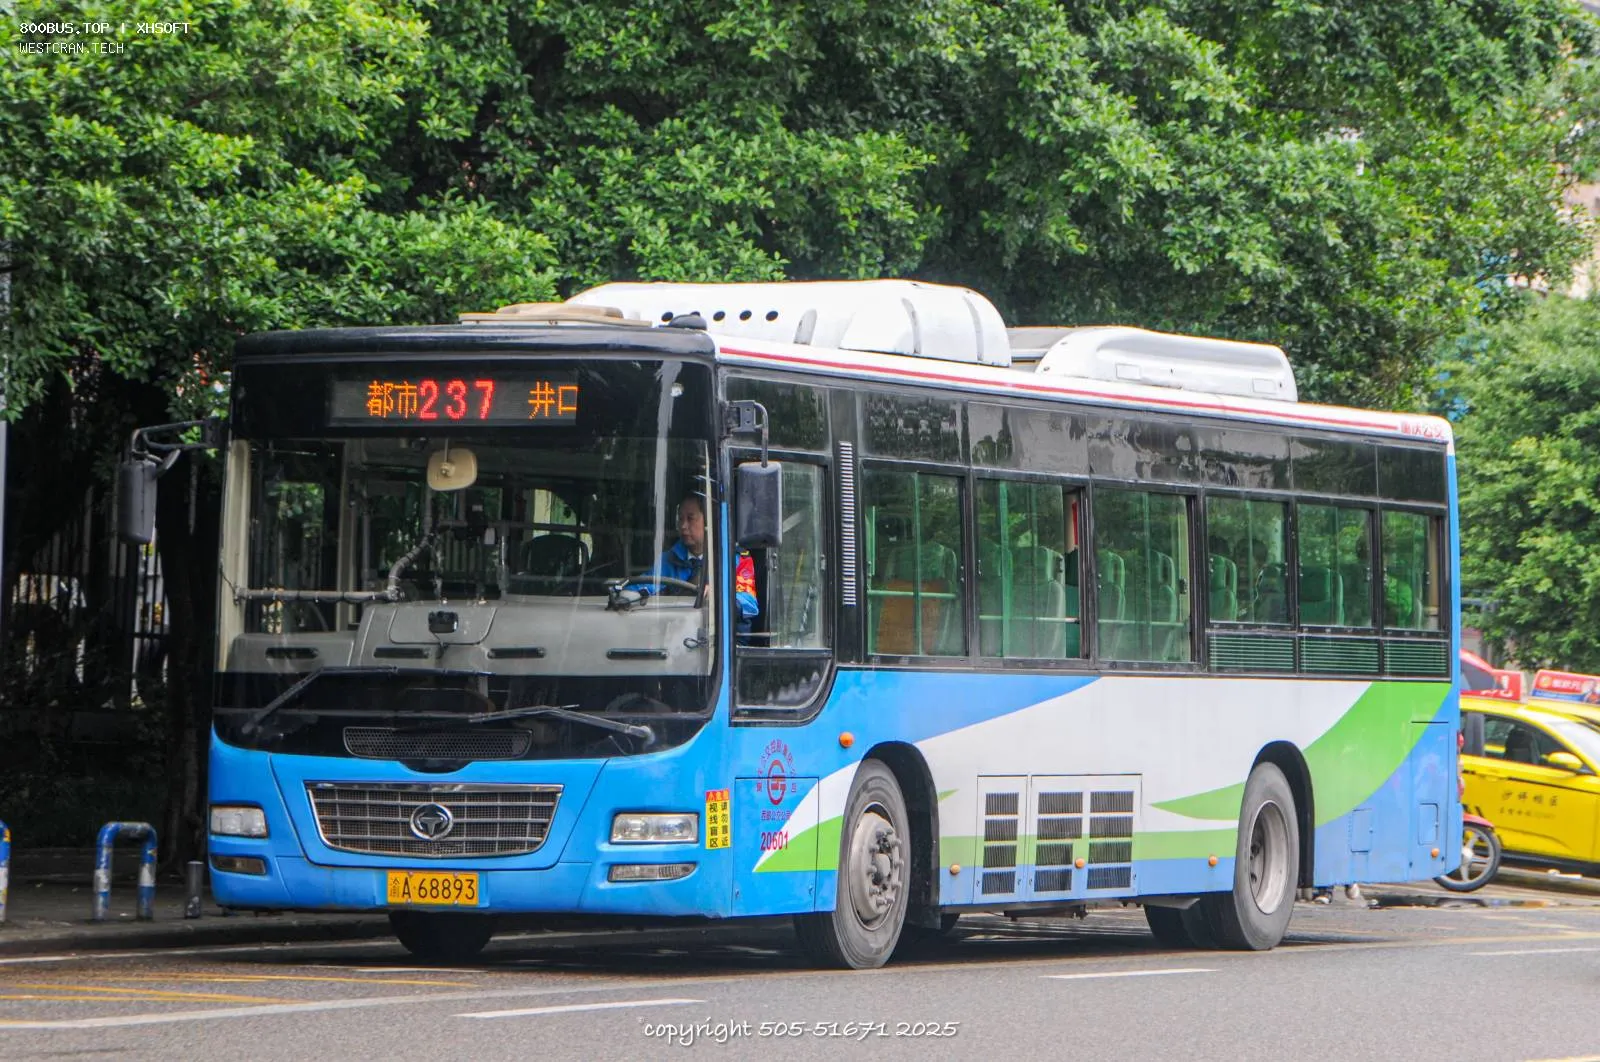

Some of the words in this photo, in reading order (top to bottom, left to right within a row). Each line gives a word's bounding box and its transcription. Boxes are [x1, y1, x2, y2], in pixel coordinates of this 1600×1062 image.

[528, 381, 578, 420] 井口
[709, 802, 718, 848] 视线盲区
[760, 831, 788, 851] 20601
